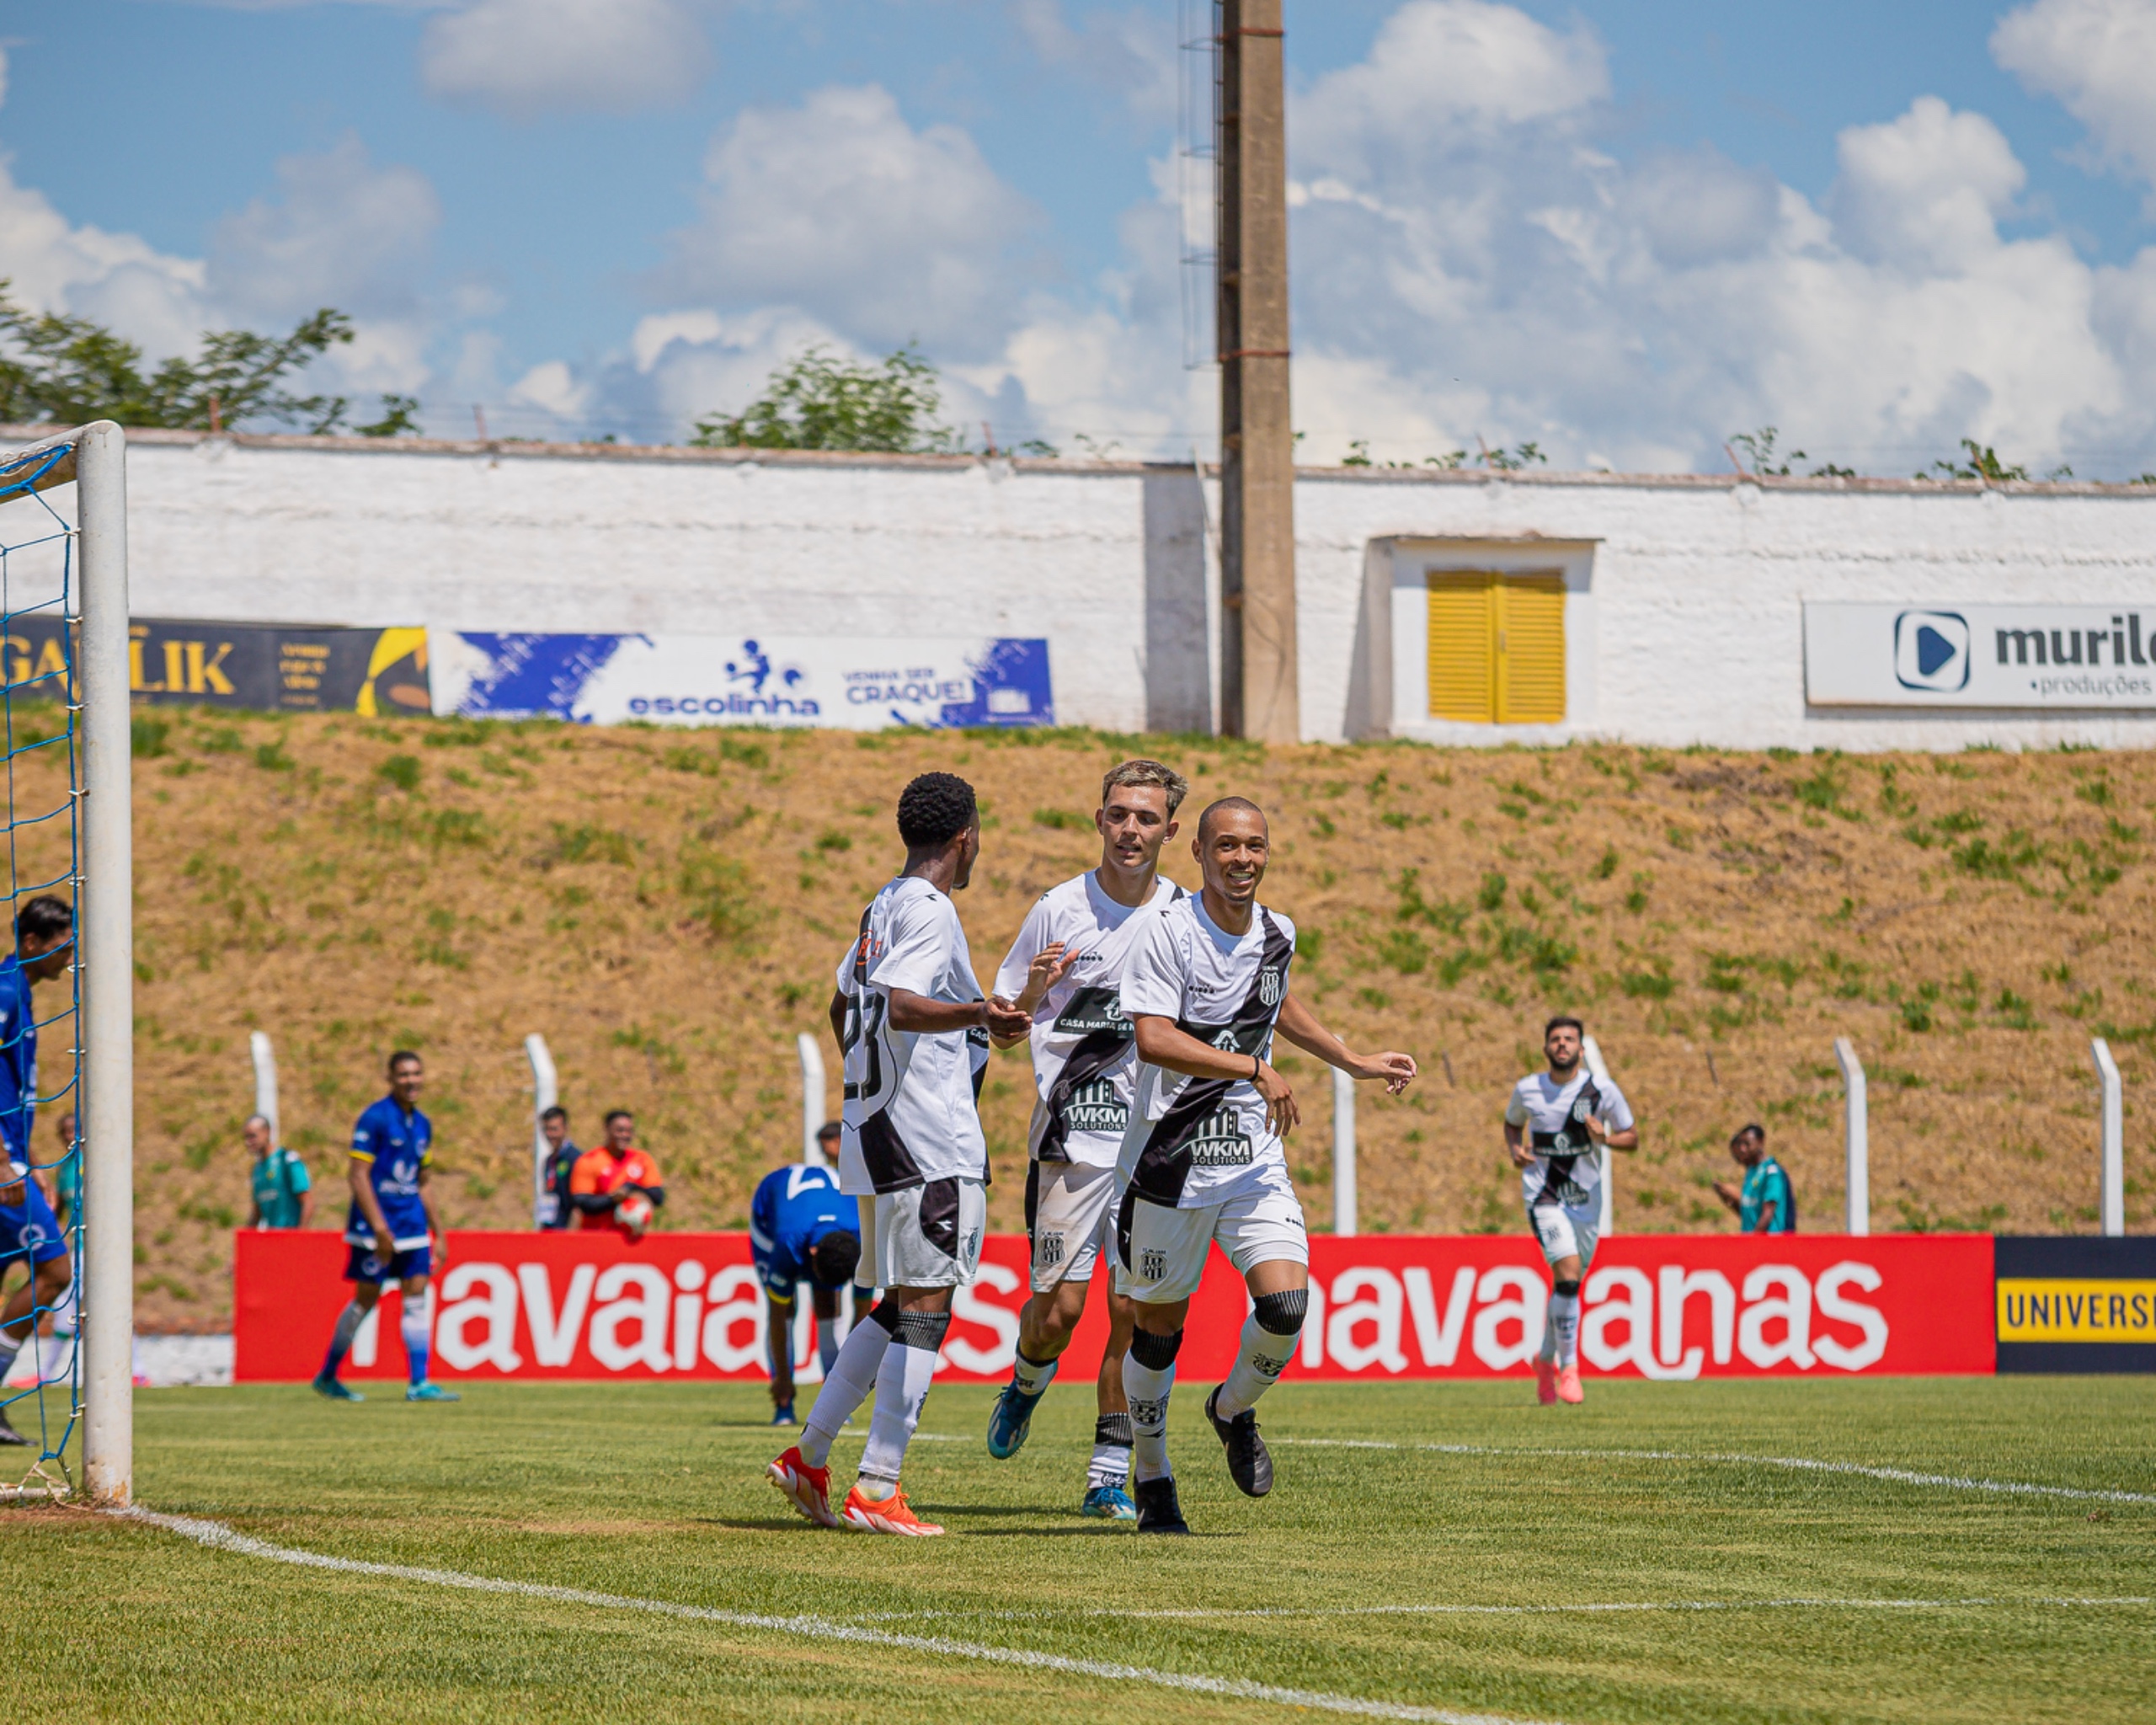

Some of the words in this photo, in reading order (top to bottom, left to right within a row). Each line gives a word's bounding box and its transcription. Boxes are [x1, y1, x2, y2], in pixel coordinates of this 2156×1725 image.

[846, 680, 965, 705] CRAQUE!
[2039, 674, 2153, 698] produções
[629, 693, 820, 715] escolinha
[1060, 1018, 1085, 1028] CASA
[1068, 1107, 1127, 1124] WKM
[1070, 1122, 1128, 1130] SOLUTIONS
[1191, 1140, 1251, 1157] WKM
[1193, 1156, 1251, 1165] SOLUTIONS
[1300, 1261, 1889, 1381] avaanas
